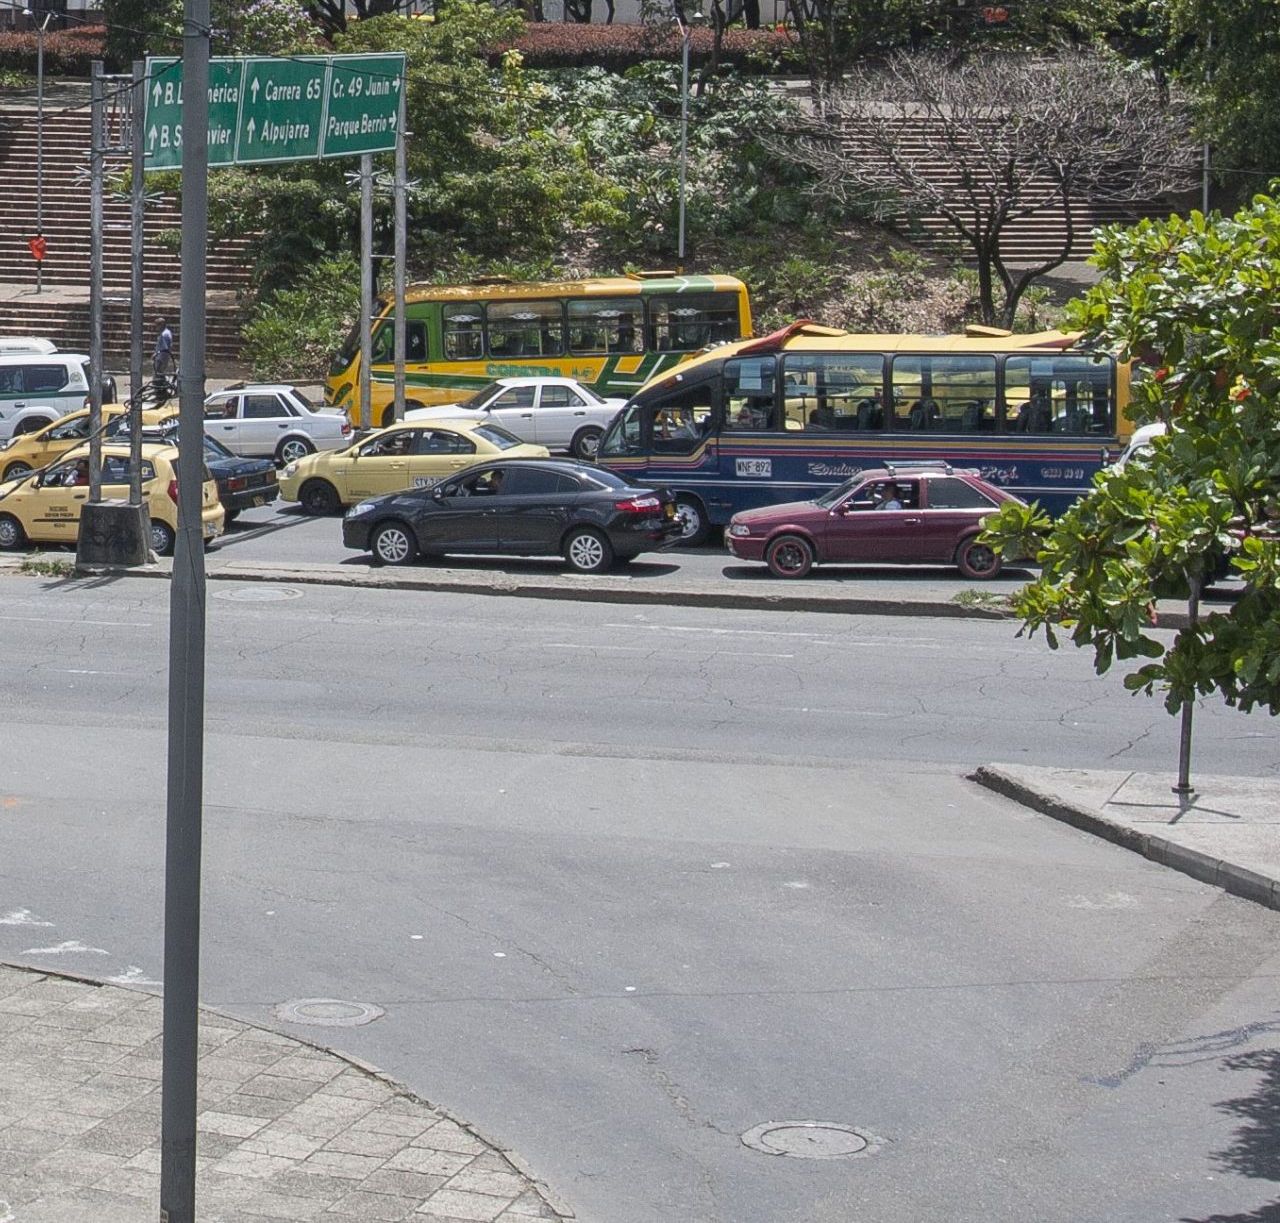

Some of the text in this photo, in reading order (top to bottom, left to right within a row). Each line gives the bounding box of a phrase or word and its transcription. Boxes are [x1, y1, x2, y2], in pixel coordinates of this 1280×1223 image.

[164, 82, 174, 105] B.
[265, 78, 321, 101] Carrera 65
[332, 78, 345, 99] Cr.
[347, 76, 363, 97] 49
[160, 125, 171, 148] B.
[260, 120, 310, 146] Alpujarra
[327, 116, 360, 140] Parque
